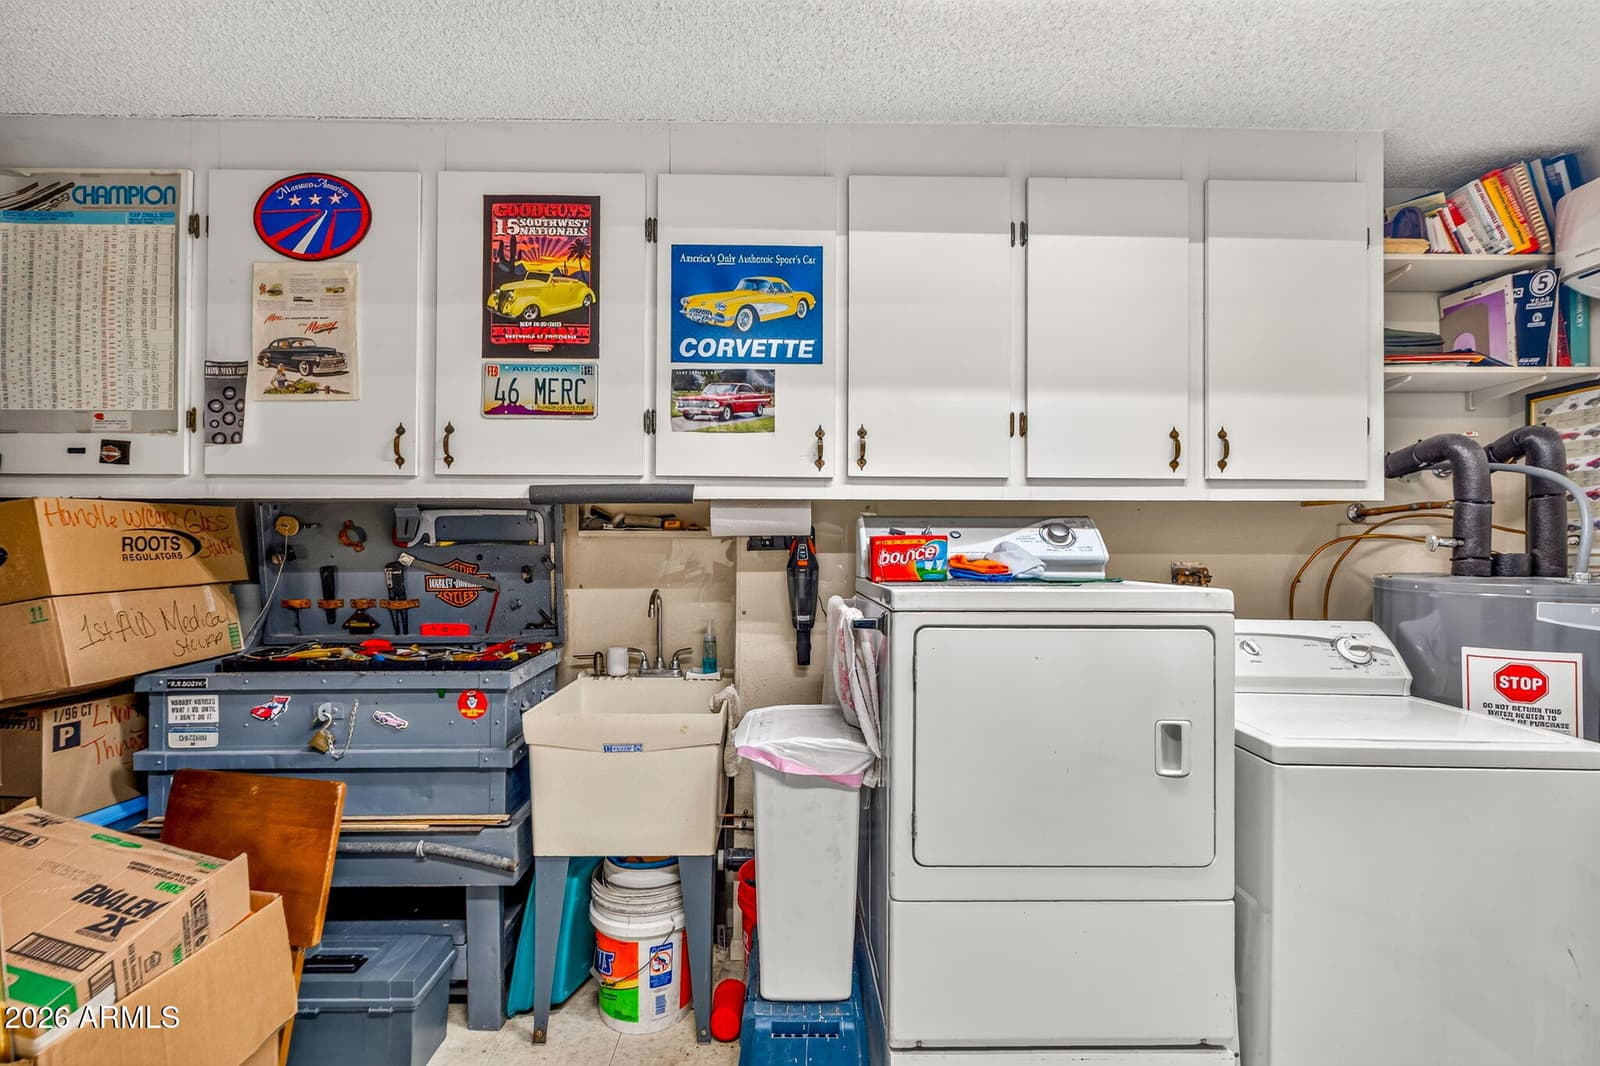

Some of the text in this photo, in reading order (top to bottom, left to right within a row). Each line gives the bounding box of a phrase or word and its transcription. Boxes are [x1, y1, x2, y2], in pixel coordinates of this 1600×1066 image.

[71, 185, 176, 205] CHAMPION
[493, 203, 591, 218] GOODGUYS
[495, 218, 519, 236] 15
[519, 218, 589, 228] SOUTHWEST
[519, 227, 589, 236] NATIONALS
[679, 253, 716, 263] America's
[717, 253, 736, 265] Only
[738, 254, 774, 265] Authentic
[802, 256, 816, 265] Car
[1537, 275, 1549, 291] 5
[679, 338, 816, 358] CORVETTE
[494, 377, 586, 405] 46 MERC
[44, 501, 119, 529] Handle
[121, 535, 181, 552] ROOTS
[121, 552, 184, 562] REGULATORS
[880, 544, 937, 566] bounce
[442, 591, 475, 604] CYCLES
[1499, 675, 1543, 691] STOP
[53, 705, 79, 722] 1/96
[81, 703, 93, 716] CT
[1488, 709, 1514, 718] WATER
[1515, 712, 1545, 721] HEATER
[1512, 705, 1542, 714] RETURN
[1529, 720, 1570, 730] PURCHASE
[58, 727, 75, 748] P
[81, 913, 140, 938] 2X
